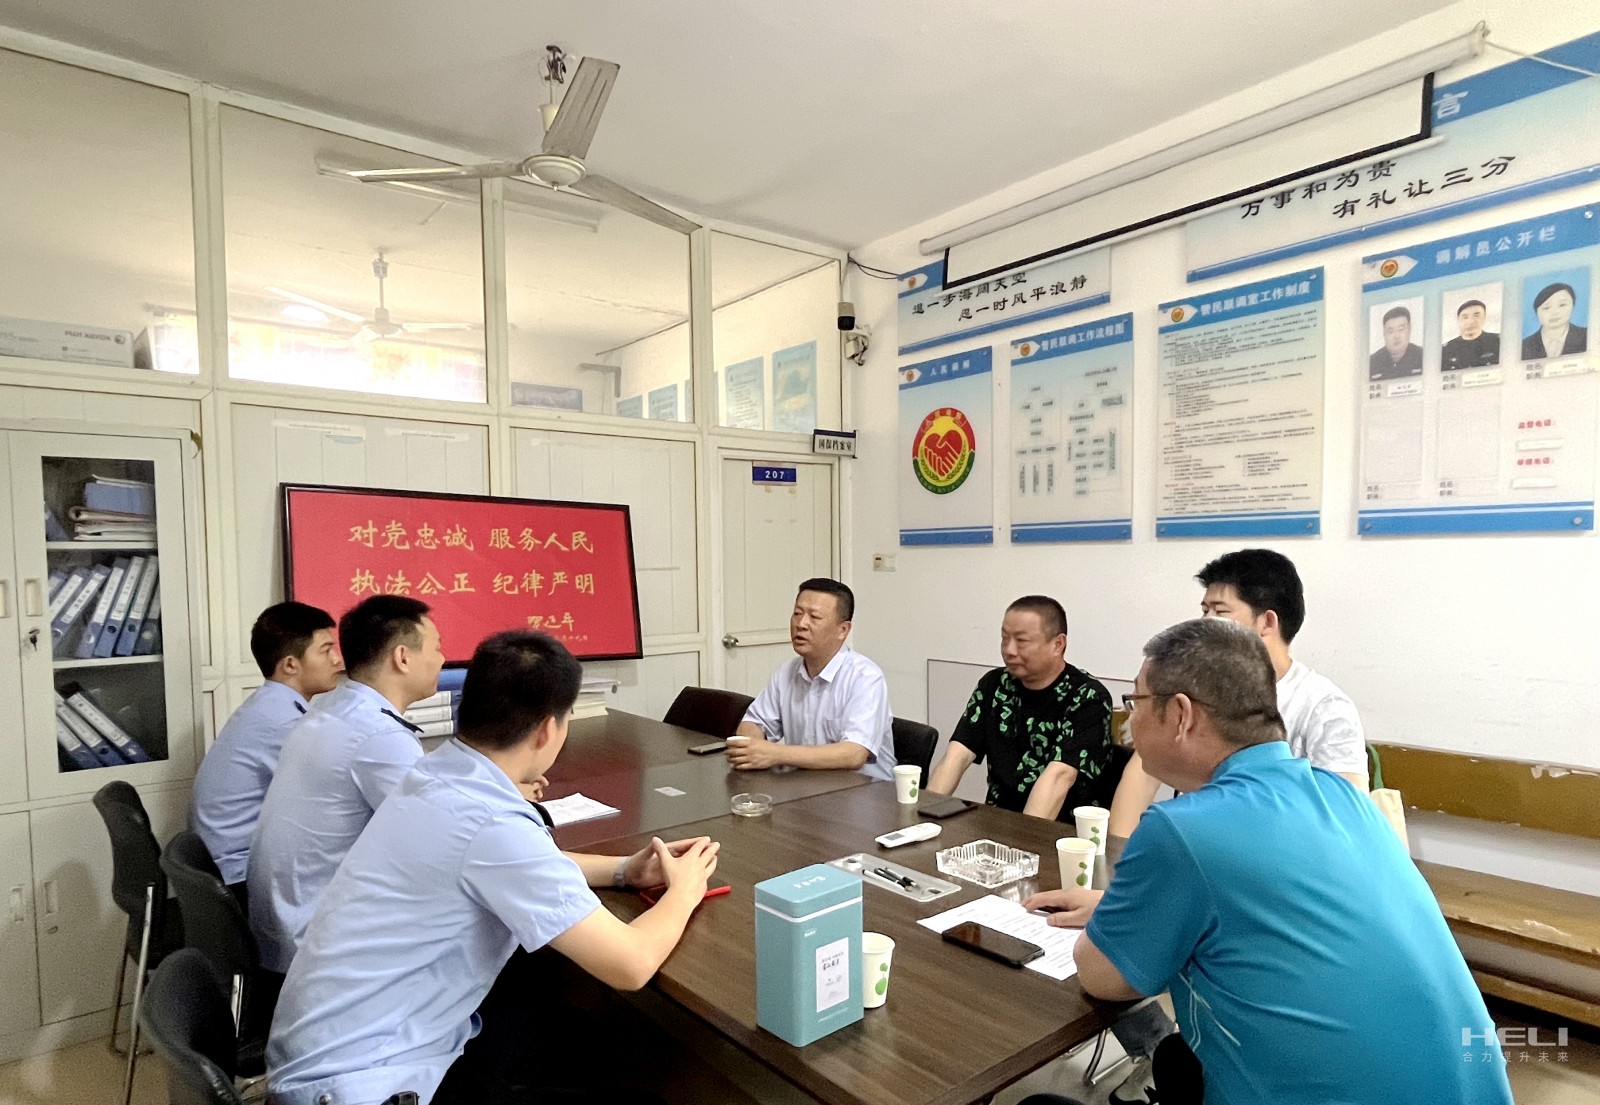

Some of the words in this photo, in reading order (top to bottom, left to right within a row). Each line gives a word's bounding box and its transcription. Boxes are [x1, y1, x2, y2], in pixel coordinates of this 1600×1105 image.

[1241, 160, 1398, 219] 万事和为贵
[1332, 156, 1516, 218] 有礼让三分
[1436, 225, 1556, 265] 调解员公开栏
[912, 273, 1027, 315] 退一步海阔天空
[958, 274, 1088, 321] 忍一时风平浪静
[764, 470, 785, 480] 207
[348, 519, 474, 551] 对党忠诚
[488, 527, 594, 554] 服务人民
[349, 567, 476, 596] 执法公正
[492, 570, 596, 597] 纪律严明
